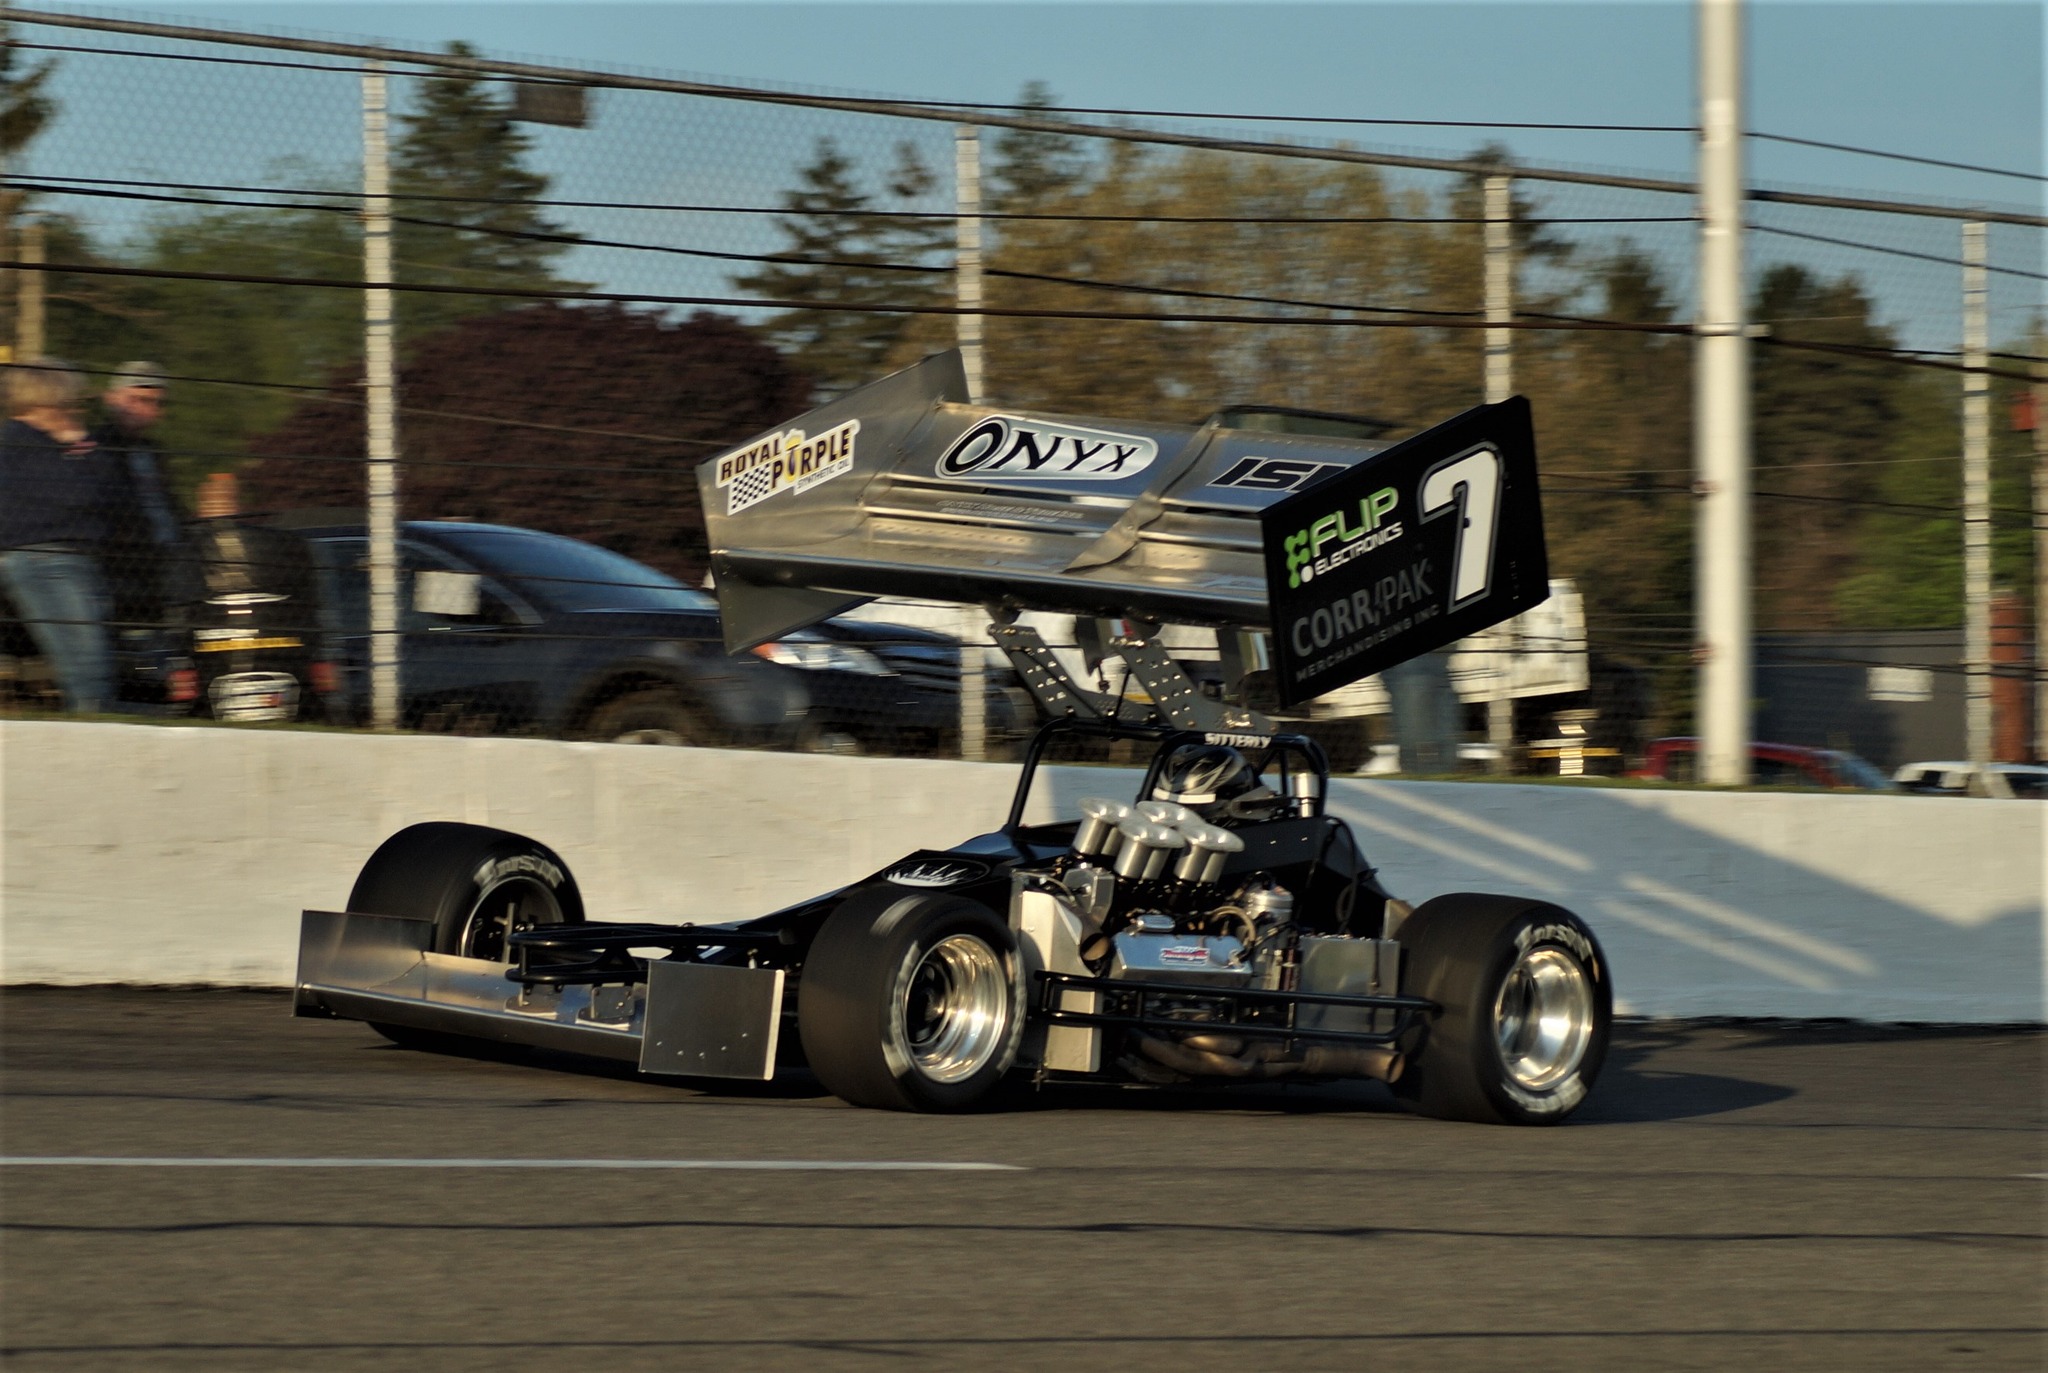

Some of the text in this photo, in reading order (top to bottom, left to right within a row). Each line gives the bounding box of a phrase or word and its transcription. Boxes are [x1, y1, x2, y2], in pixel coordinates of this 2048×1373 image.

[720, 438, 781, 482] ROYAL
[771, 427, 850, 489] PURPLE
[944, 421, 1139, 474] ONYX
[1309, 486, 1399, 558] FLIP
[1315, 521, 1403, 576] ELECTRONICS
[1296, 604, 1440, 683] MERCHANDISING INC
